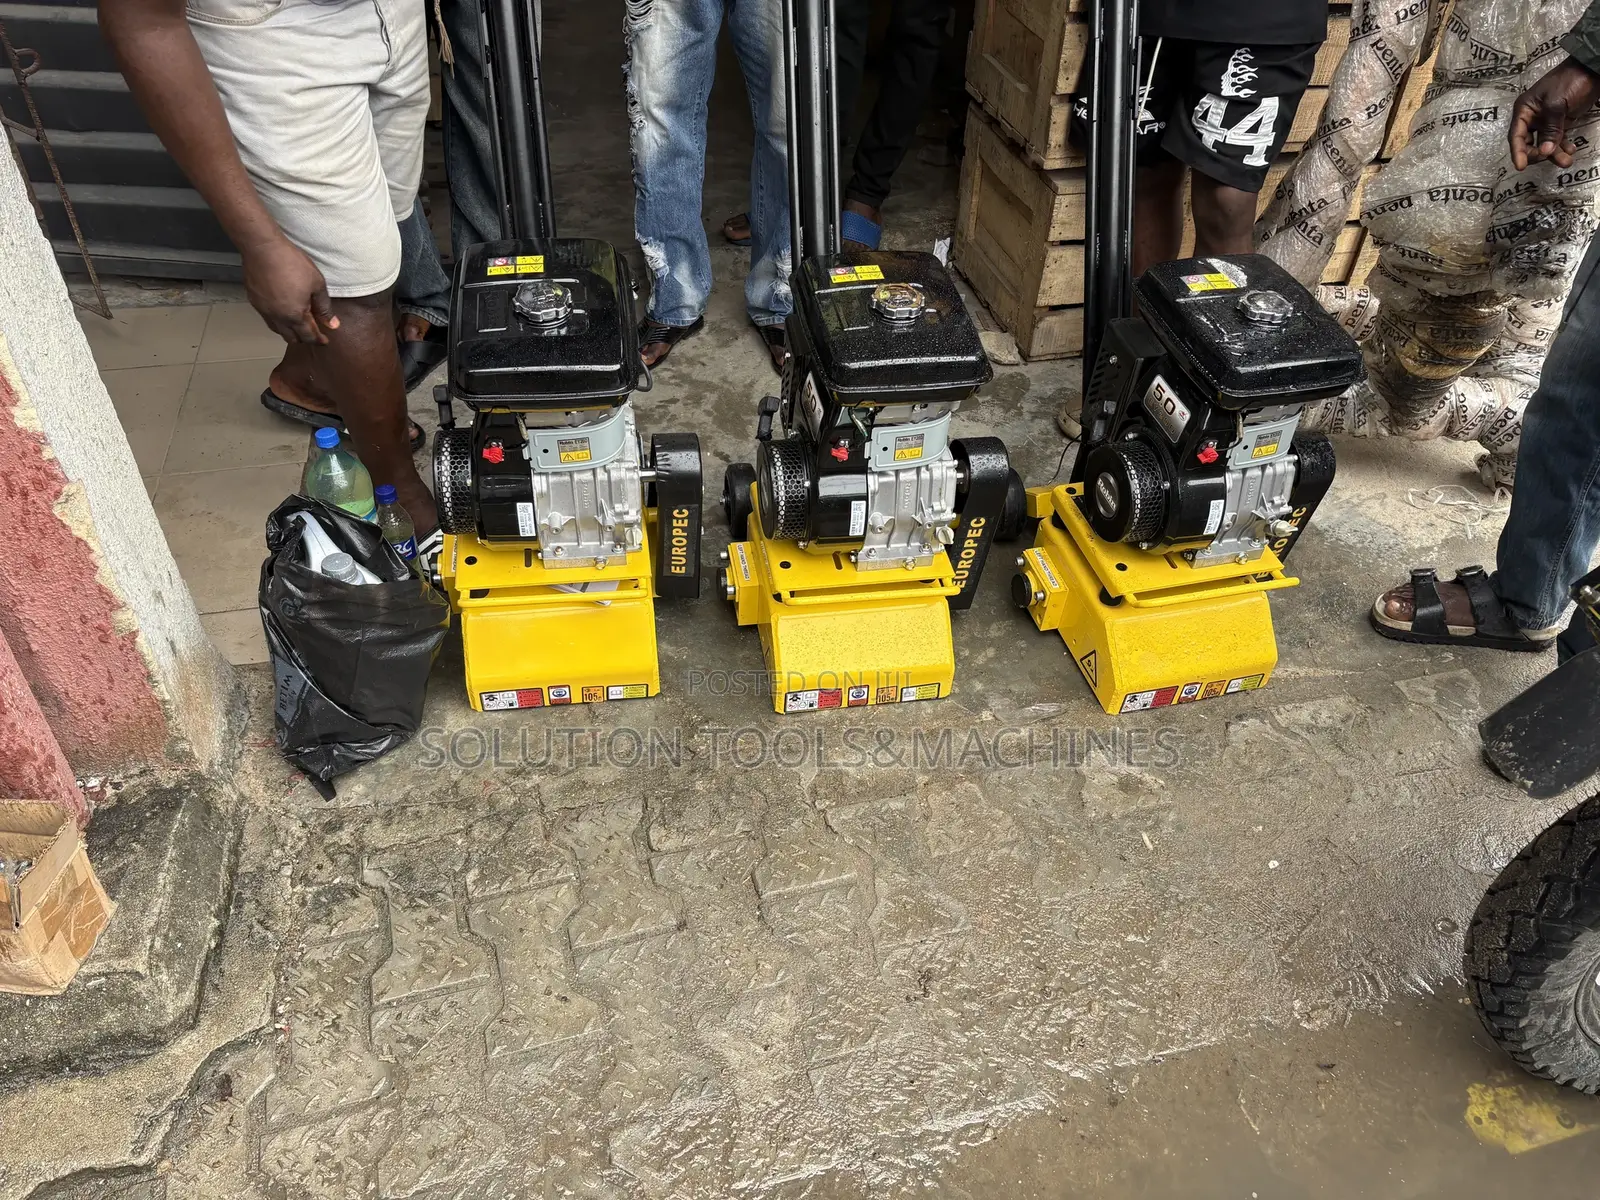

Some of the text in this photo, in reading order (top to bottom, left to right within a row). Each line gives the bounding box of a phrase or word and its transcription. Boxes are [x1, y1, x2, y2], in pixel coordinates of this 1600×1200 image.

[1394, 0, 1427, 25] pen
[1470, 41, 1516, 66] pent
[1191, 93, 1279, 167] 44
[1317, 117, 1352, 137] enta
[1442, 106, 1499, 128] penta
[1323, 136, 1356, 176] pent
[1557, 165, 1600, 188] pen
[1360, 196, 1413, 220] pent
[1427, 188, 1495, 205] penta
[1297, 220, 1325, 246] nta
[1345, 288, 1369, 329] penta
[1360, 315, 1376, 338] nta
[1457, 393, 1468, 423] pen
[1493, 421, 1521, 451] pen
[1097, 478, 1116, 511] Robin
[671, 508, 690, 575] EUROPEC
[953, 516, 986, 589] EUROPEC
